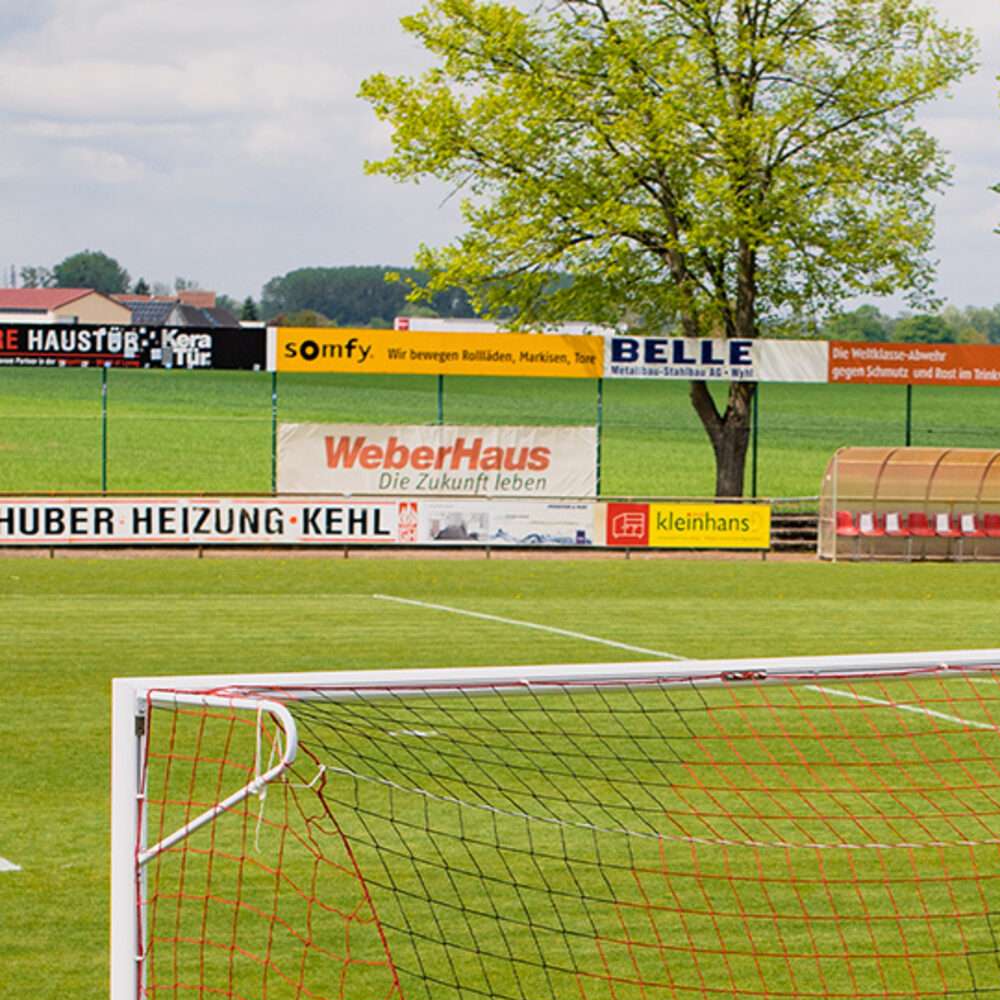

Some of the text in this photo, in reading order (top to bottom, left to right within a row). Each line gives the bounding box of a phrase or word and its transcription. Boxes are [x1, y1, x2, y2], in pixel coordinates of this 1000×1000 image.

[0, 329, 18, 350] E
[161, 328, 212, 348] Kera
[285, 338, 373, 363] somfy
[388, 348, 407, 359] Wir
[410, 348, 459, 363] bewegen
[520, 351, 571, 365] Markisen,
[575, 352, 597, 364] Tore
[611, 338, 753, 365] BELLE
[832, 347, 849, 359] Die
[832, 367, 865, 380] gegen
[866, 365, 909, 378] Schmutz
[912, 367, 933, 379] und
[935, 367, 957, 379] Rost
[324, 436, 551, 471] WeberHaus
[379, 473, 548, 494] Die Zukunft leben
[0, 507, 391, 535] HUBER HEIZUNG KEHL
[656, 512, 750, 532] kleinhans
